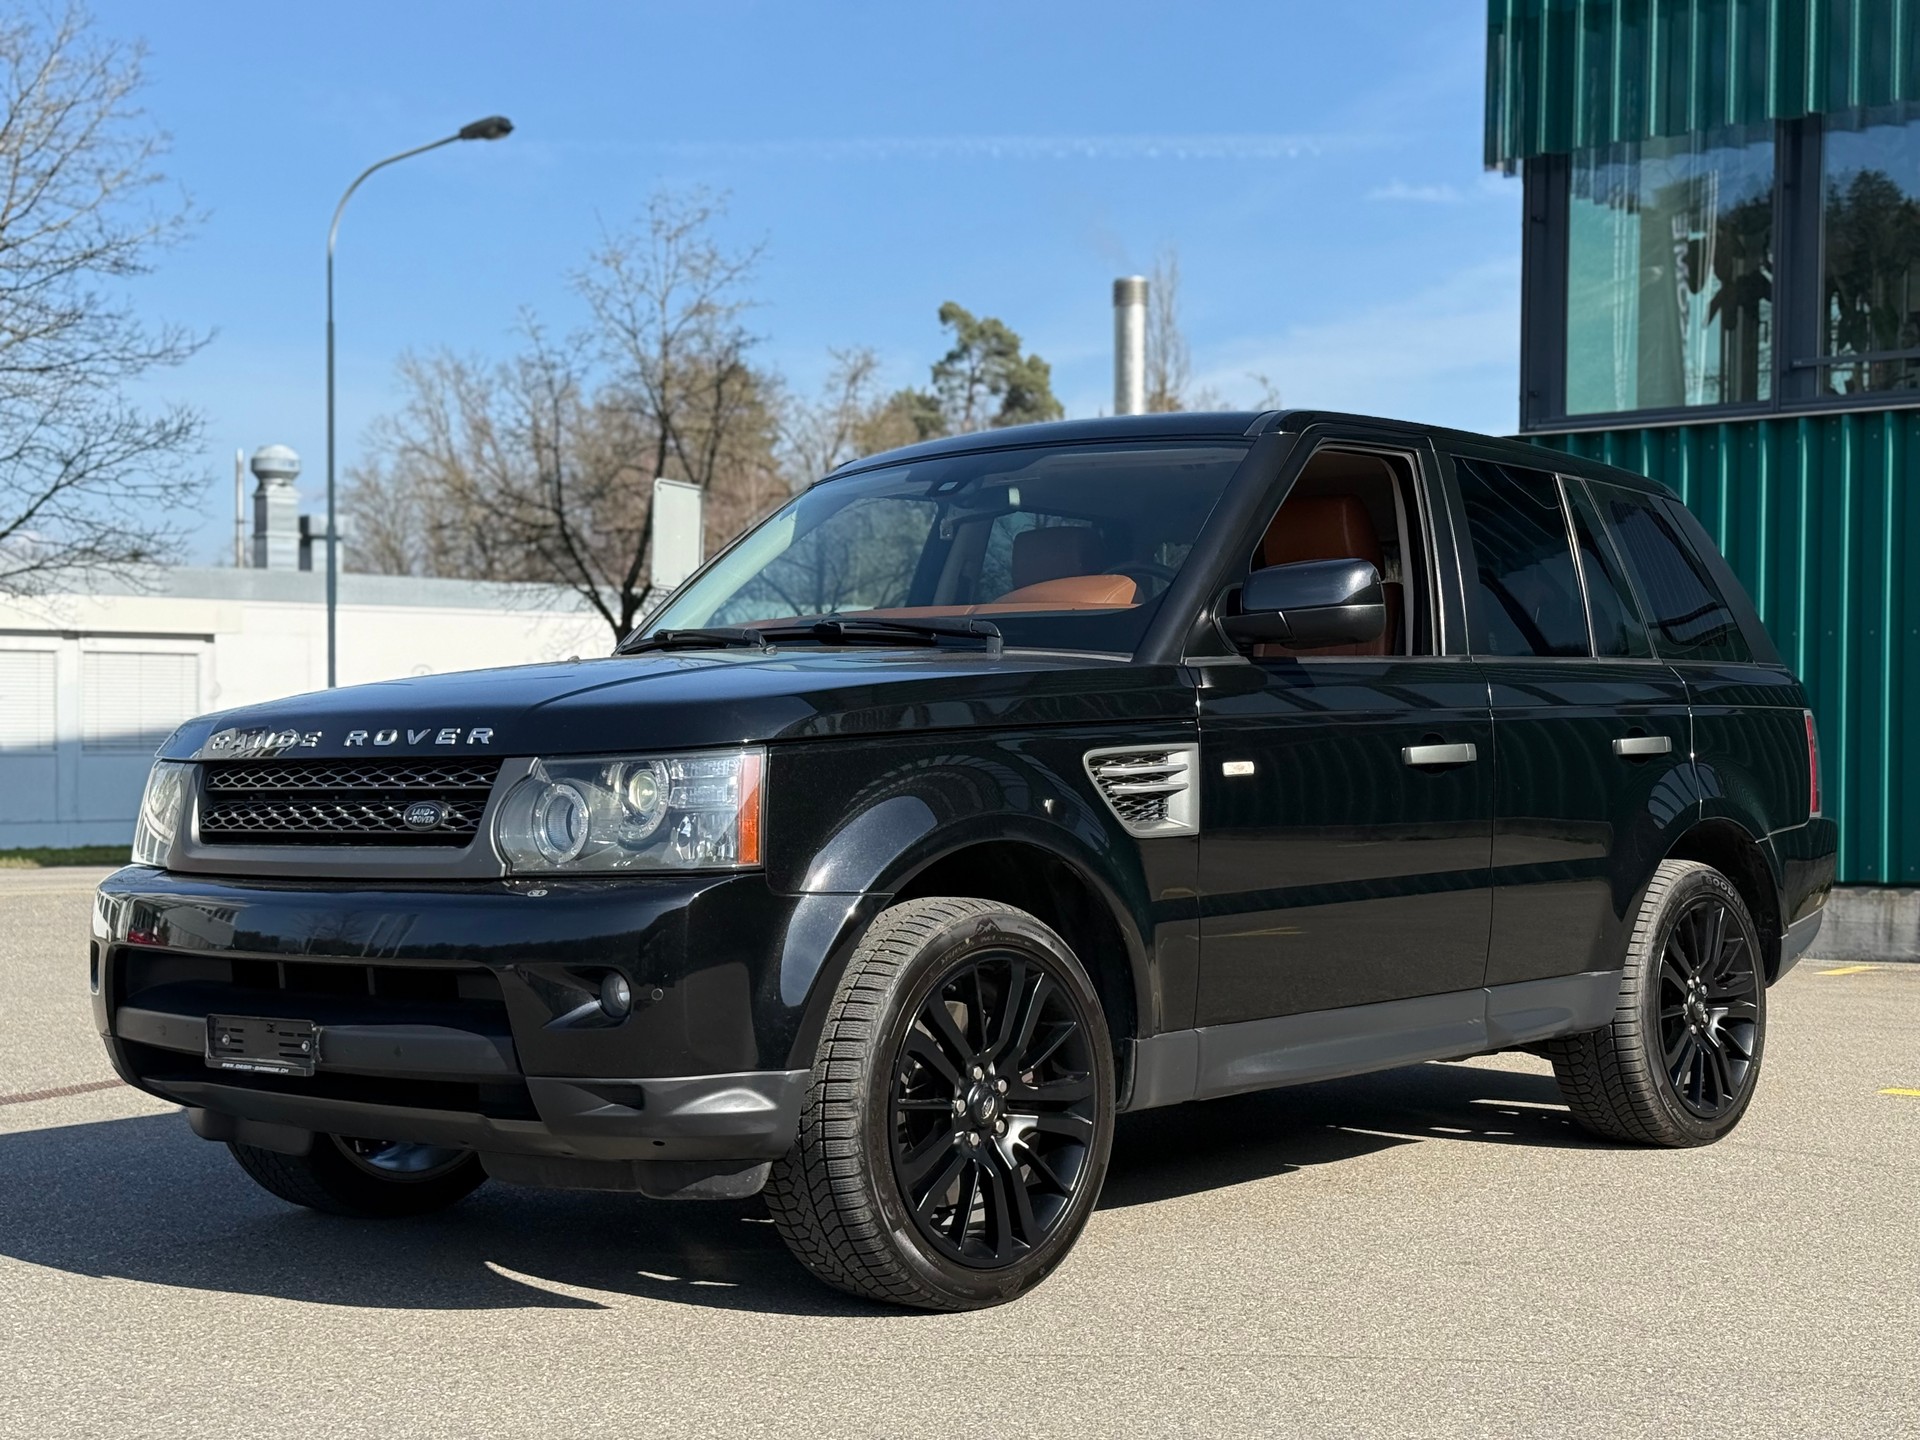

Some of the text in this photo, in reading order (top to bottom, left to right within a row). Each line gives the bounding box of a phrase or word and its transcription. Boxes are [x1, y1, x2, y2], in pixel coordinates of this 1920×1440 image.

[212, 728, 494, 750] RANGE ROVER
[411, 808, 431, 816] LAND
[411, 815, 435, 823] ROVER
